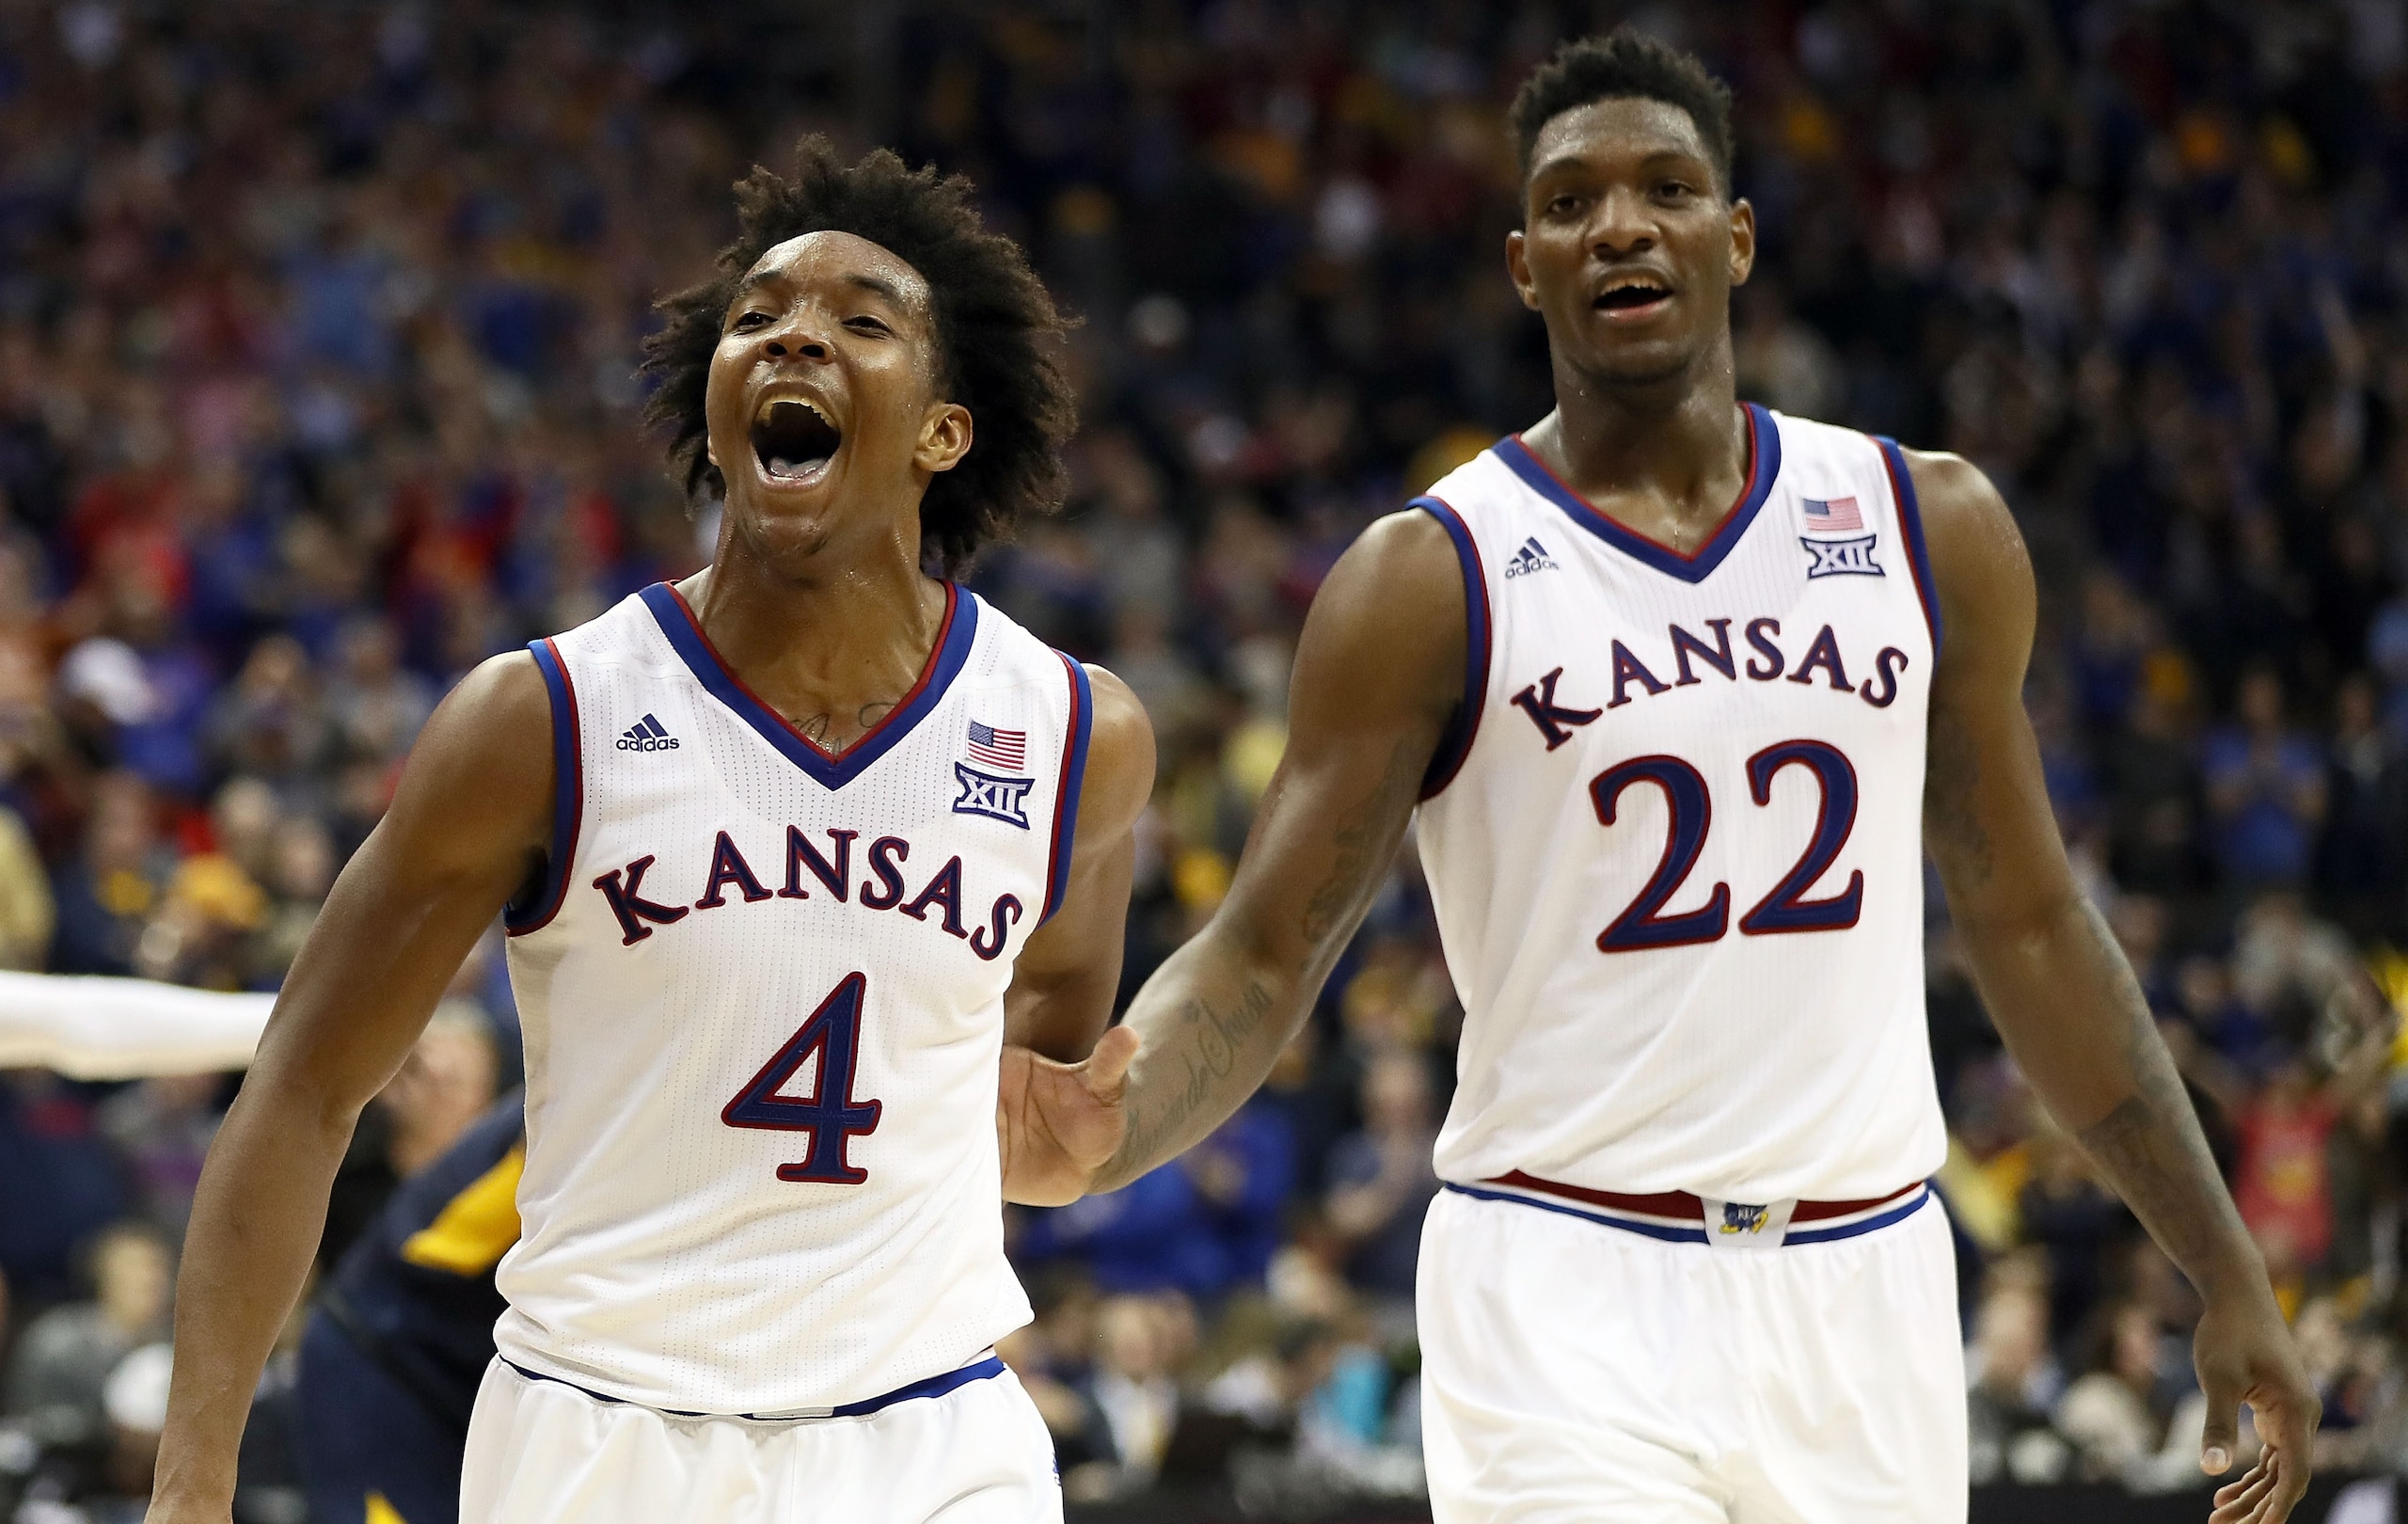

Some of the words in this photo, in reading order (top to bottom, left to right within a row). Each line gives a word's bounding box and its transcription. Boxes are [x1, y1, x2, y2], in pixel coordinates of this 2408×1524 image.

[1505, 558, 1559, 579] adidas
[1803, 539, 1880, 577] XII
[1510, 618, 1909, 752] KANSAS
[616, 737, 680, 753] adidas
[956, 767, 1030, 825] XII
[593, 825, 1023, 960] KANSAS
[1589, 738, 1863, 953] 22
[721, 971, 882, 1184] 4
